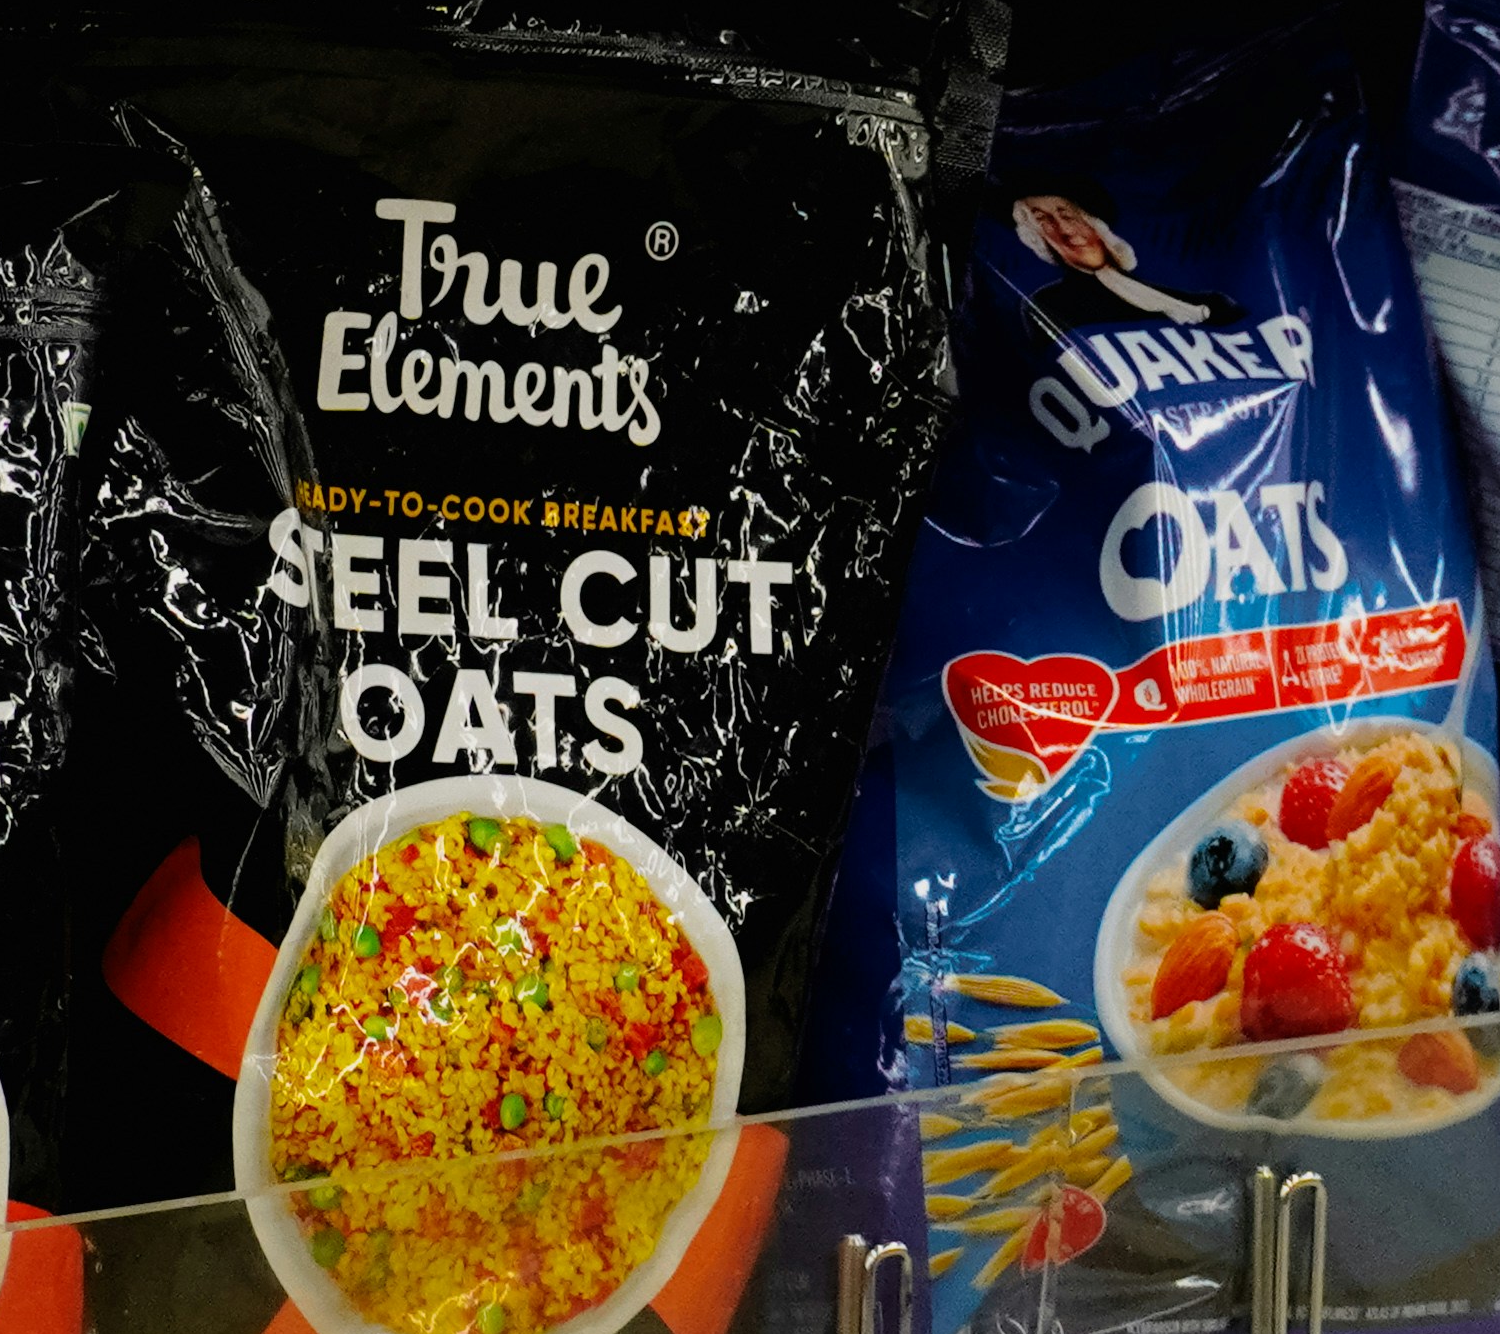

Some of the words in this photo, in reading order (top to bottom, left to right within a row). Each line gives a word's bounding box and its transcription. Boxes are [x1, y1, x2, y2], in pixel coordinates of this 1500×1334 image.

[376, 197, 625, 332] True
[315, 310, 663, 448] Elements
[1029, 315, 1316, 454] QUAKER
[559, 547, 795, 657] CUT
[1099, 480, 1350, 623] OATS
[339, 661, 646, 777] OATS
[969, 685, 1024, 706] HELPS
[1028, 682, 1098, 700] REDUCE
